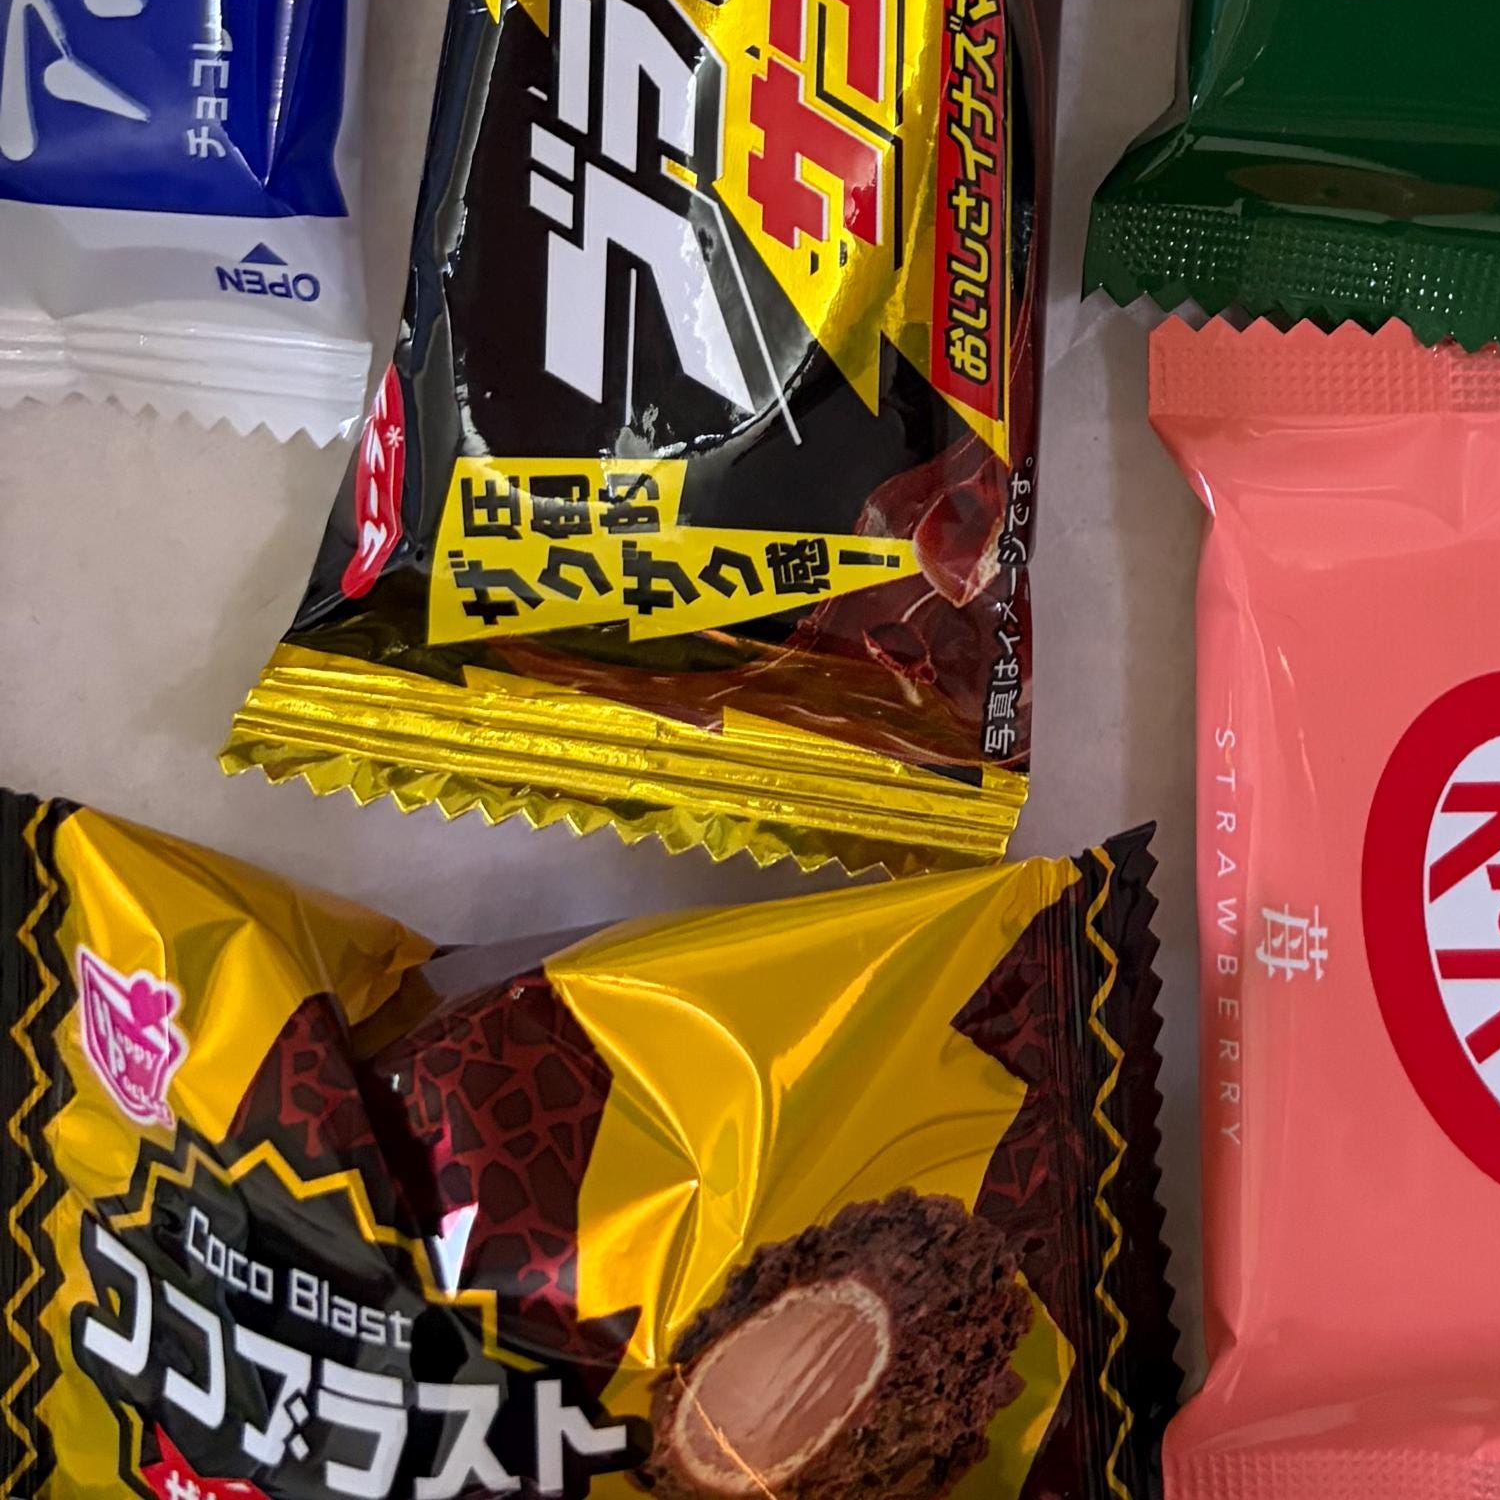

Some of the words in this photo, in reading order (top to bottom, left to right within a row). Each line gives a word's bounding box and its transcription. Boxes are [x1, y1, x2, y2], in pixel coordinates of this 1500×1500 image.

[215, 266, 321, 303] OPEN
[460, 472, 662, 540] 圧倒的
[1213, 727, 1242, 1146] STRAWBERRY
[186, 1205, 273, 1302] Coco
[288, 1274, 413, 1350] Blast
[82, 1226, 627, 1498] ココブラスト
